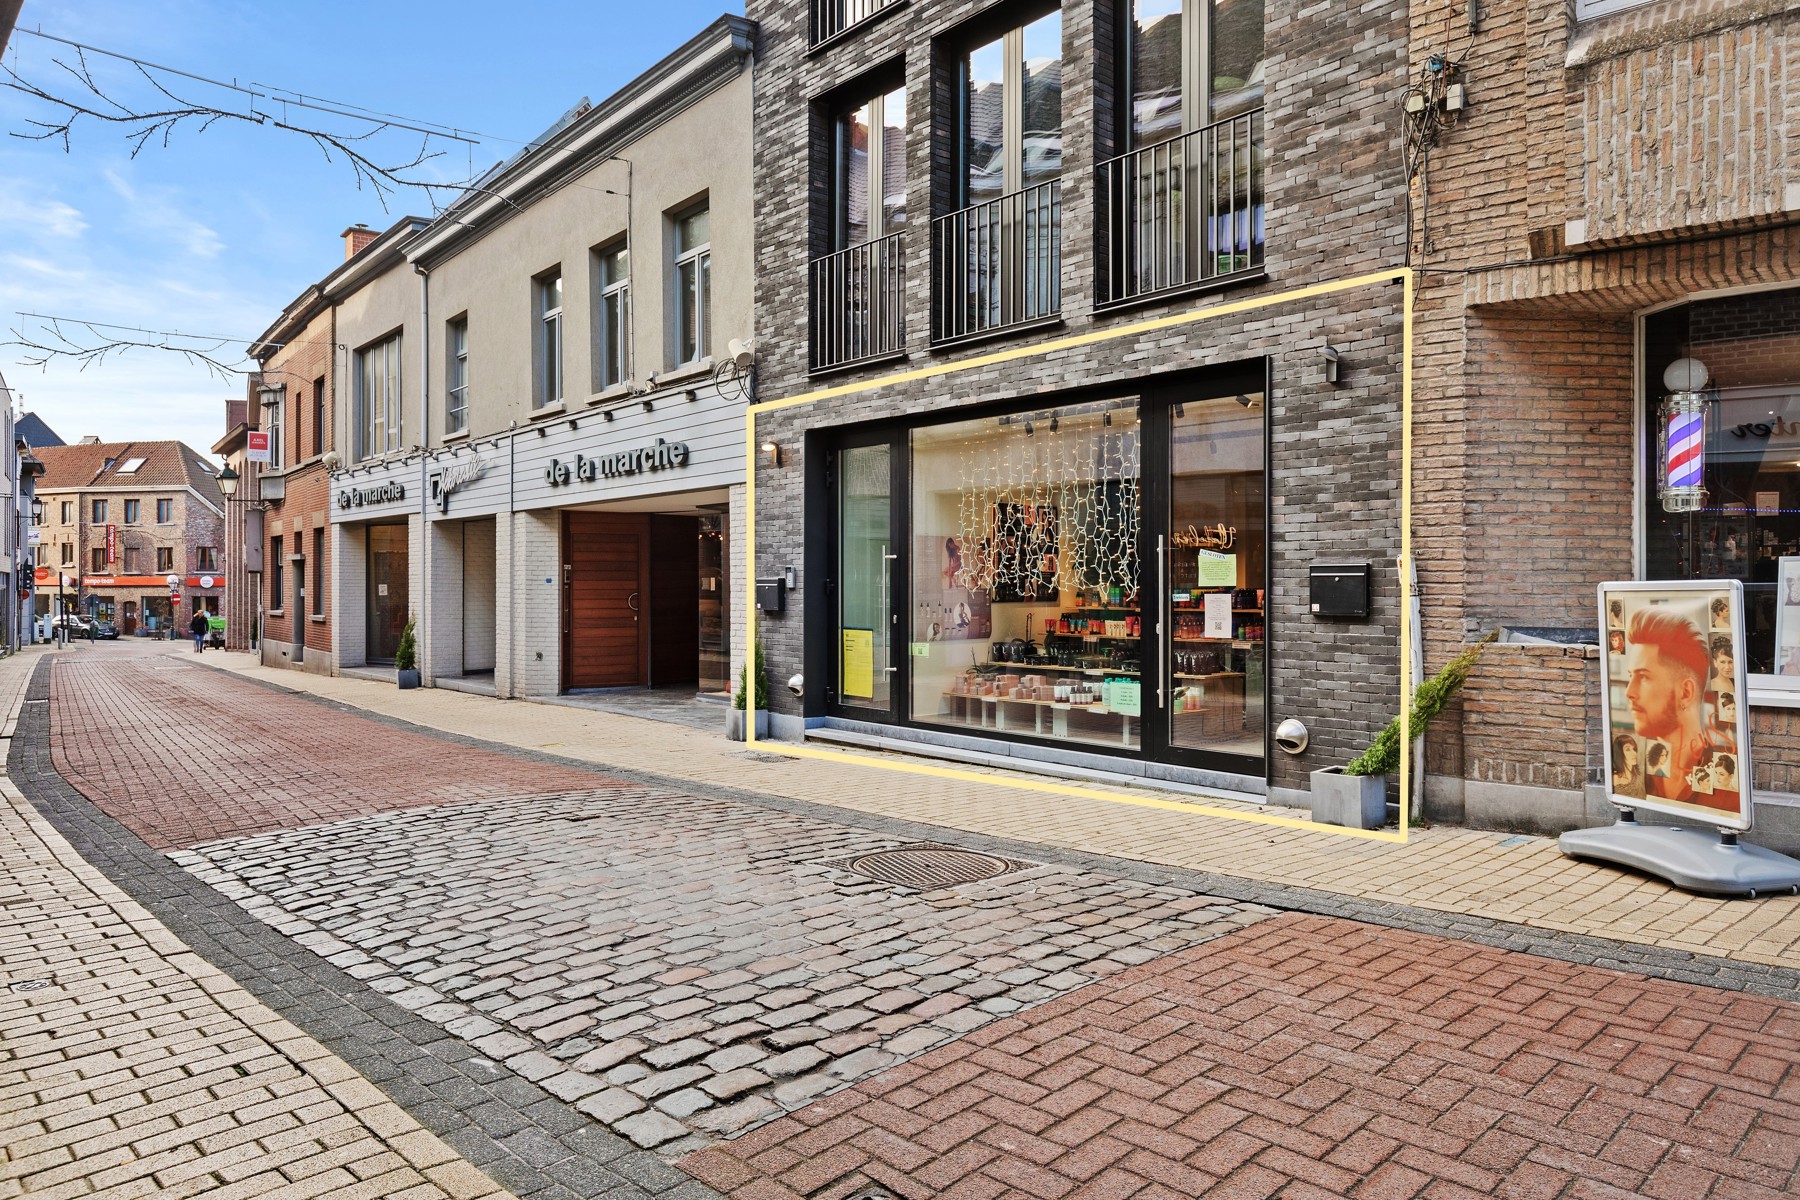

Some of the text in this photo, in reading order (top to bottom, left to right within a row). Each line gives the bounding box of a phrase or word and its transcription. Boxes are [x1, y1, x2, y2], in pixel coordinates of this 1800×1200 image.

[544, 438, 689, 485] de la marche
[336, 481, 405, 508] de la marche
